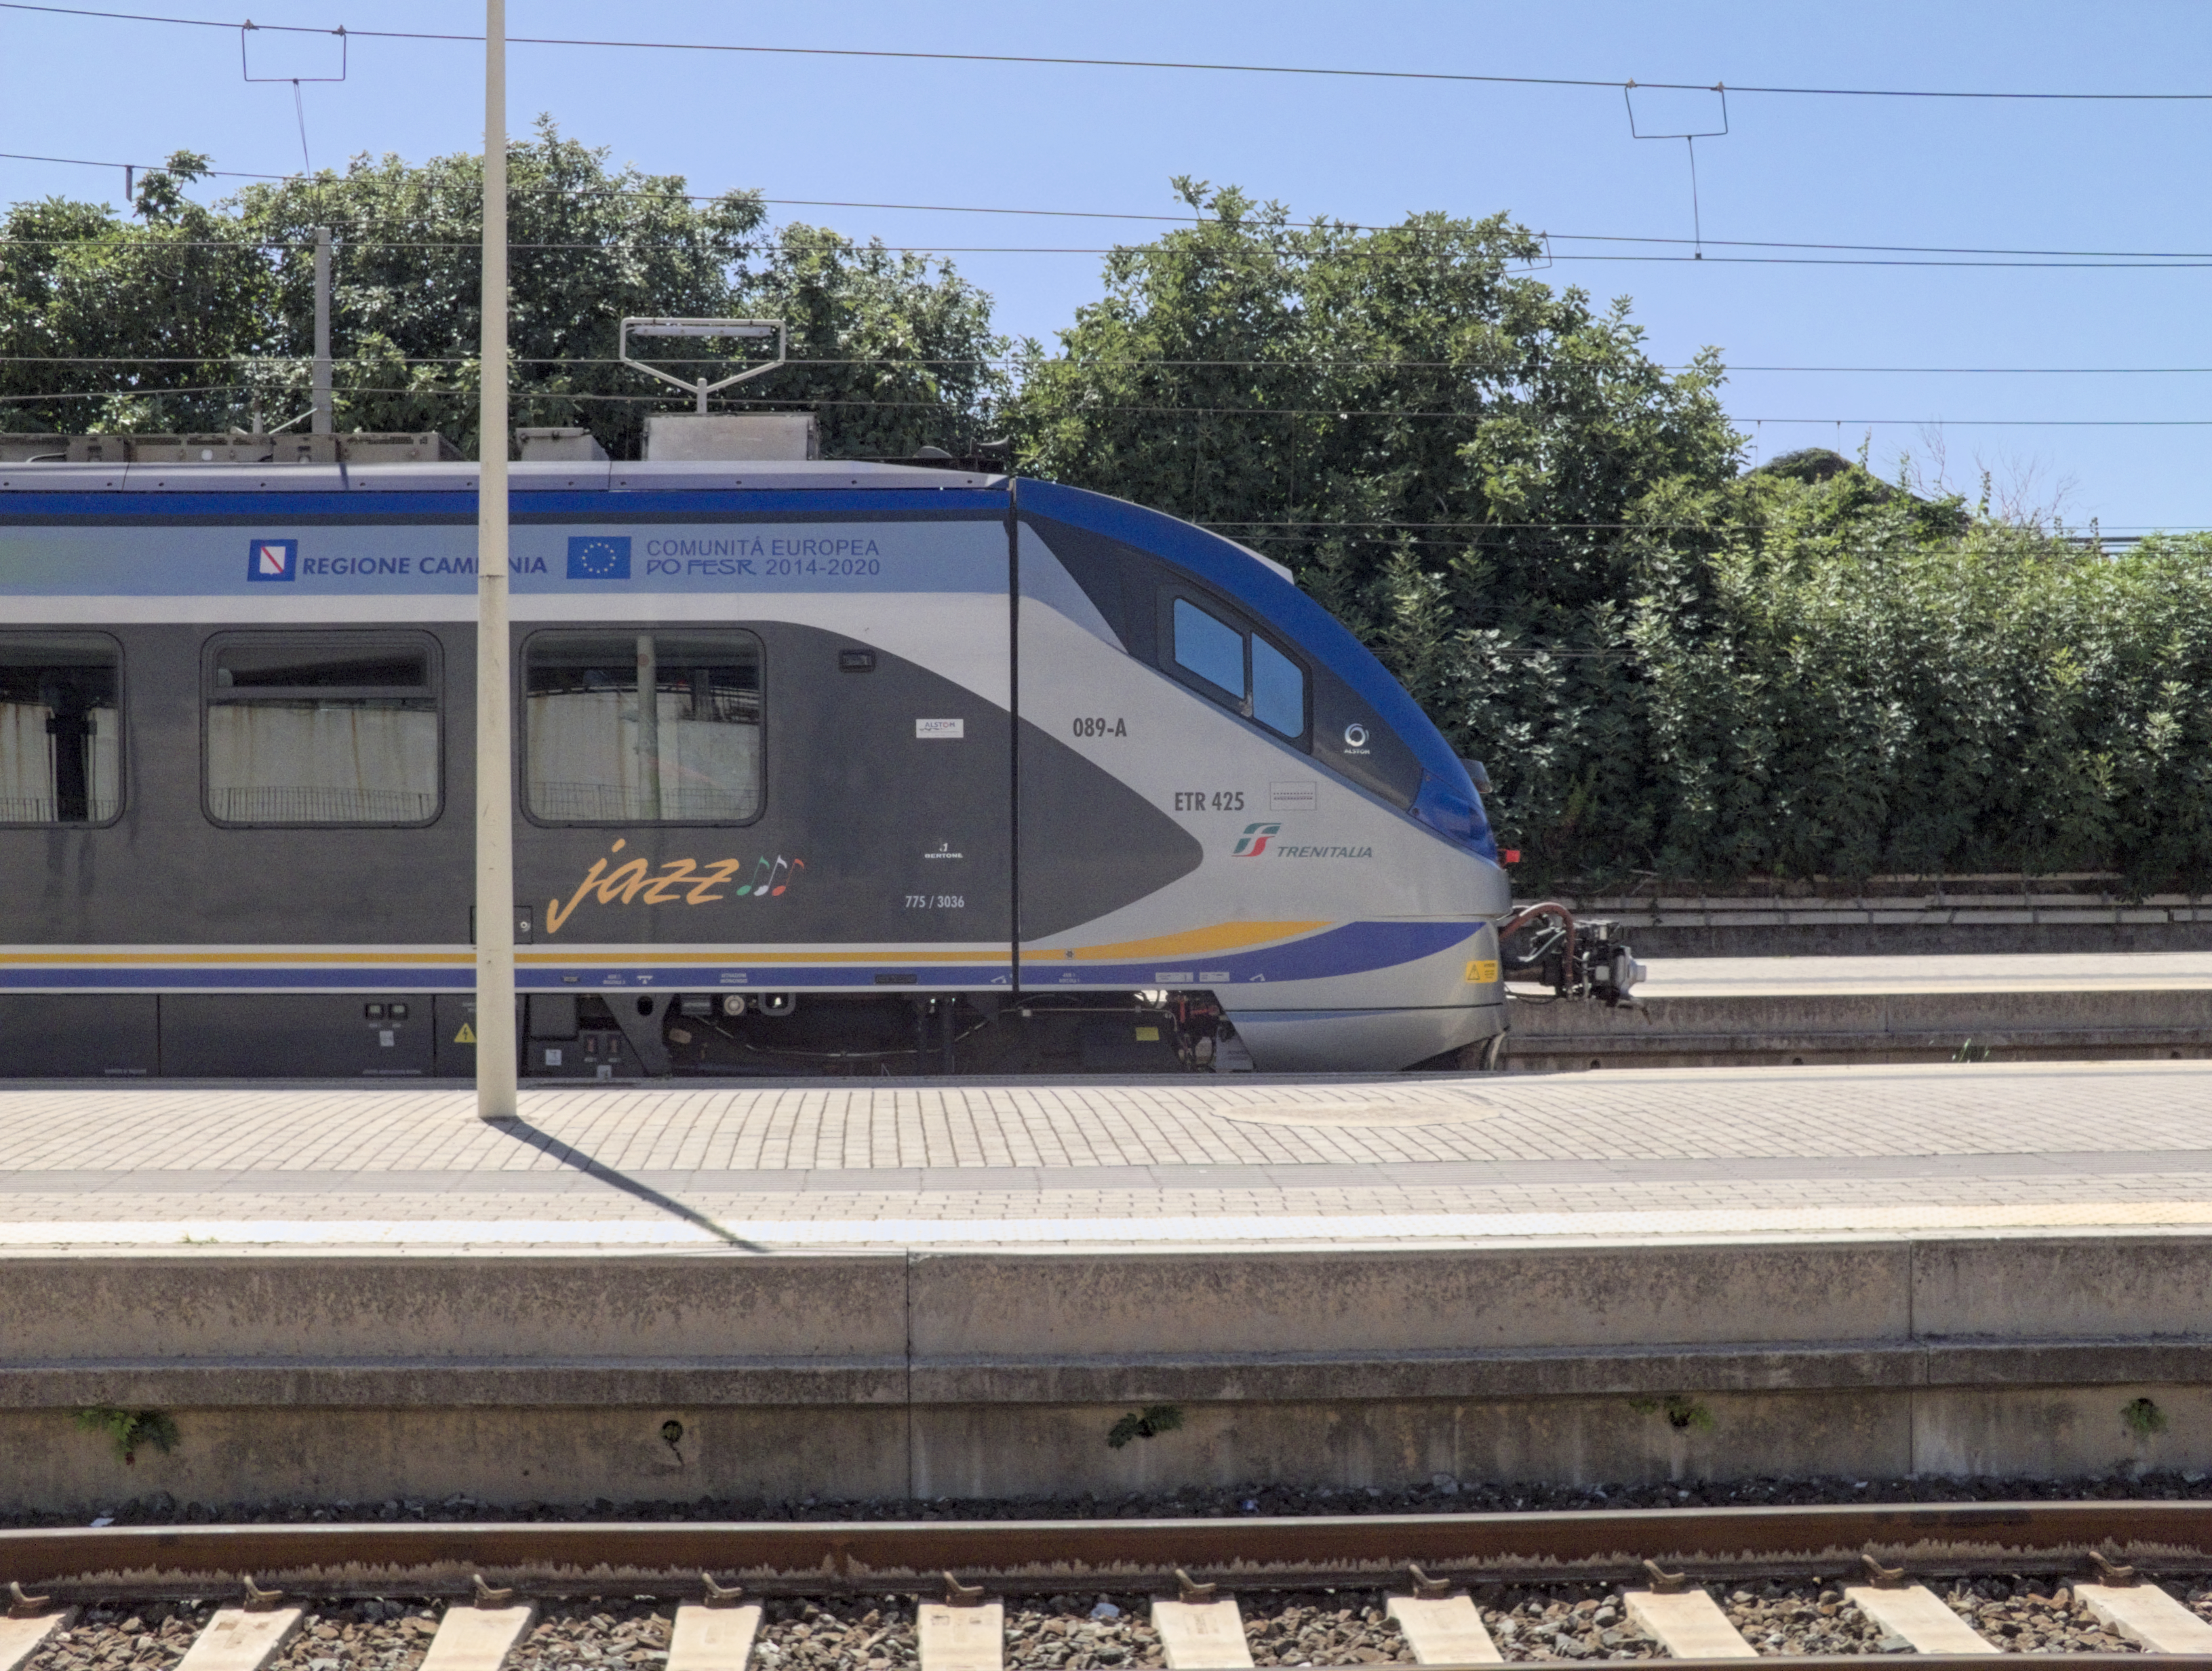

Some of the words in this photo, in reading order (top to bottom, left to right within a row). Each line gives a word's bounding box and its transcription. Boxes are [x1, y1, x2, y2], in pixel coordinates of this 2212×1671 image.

[772, 539, 880, 555] EUROPEA
[302, 557, 410, 575] REGIONE
[419, 556, 547, 575] CAMNIA
[646, 559, 681, 575] PO
[688, 559, 757, 575] FESR
[766, 558, 880, 575] 2014-2020
[1073, 717, 1127, 737] 089-A
[1174, 791, 1206, 811] ETR
[1212, 791, 1244, 811] 425
[1277, 846, 1372, 858] TRENITALIA
[547, 838, 740, 935] jazz
[905, 895, 926, 908] 775
[928, 895, 934, 909] /
[937, 895, 965, 908] 3036
